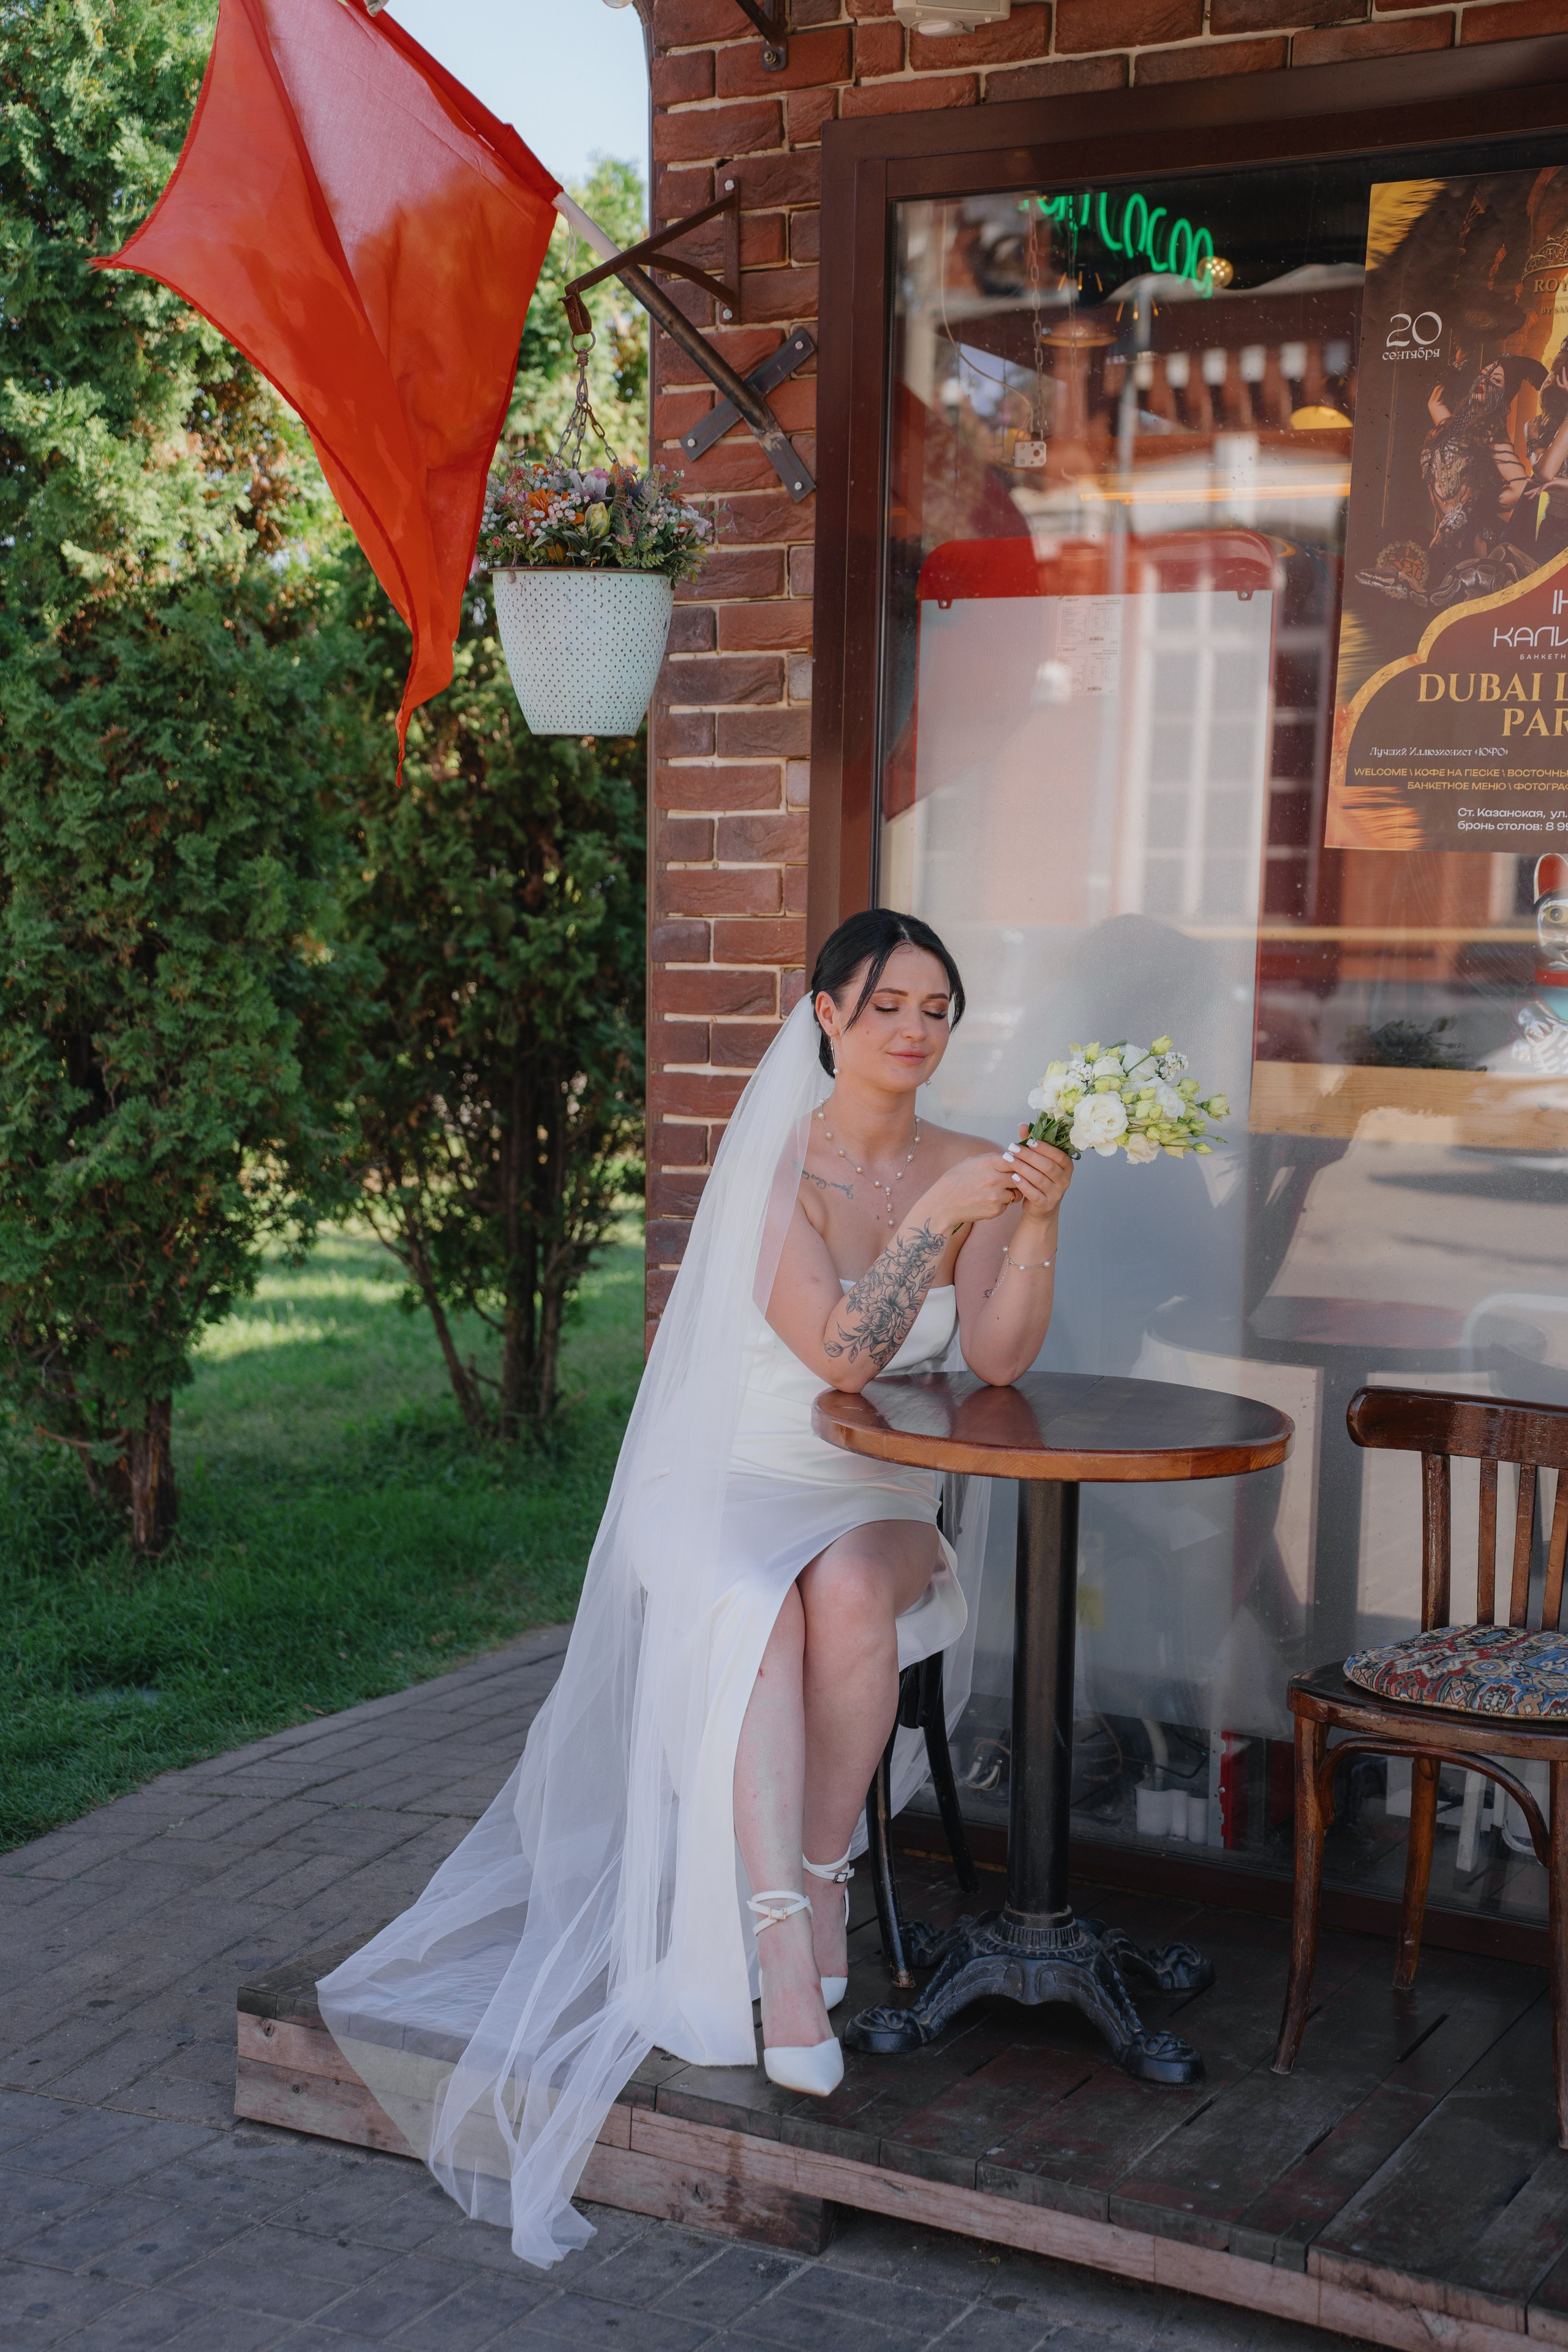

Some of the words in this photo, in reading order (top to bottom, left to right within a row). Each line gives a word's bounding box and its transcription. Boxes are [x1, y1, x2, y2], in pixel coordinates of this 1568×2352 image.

[1386, 311, 1442, 347] 20
[1382, 347, 1441, 361] сентября
[1417, 673, 1544, 702] DUBAI
[1370, 747, 1408, 758] Лучший
[1409, 747, 1472, 756] Иллюзионист
[1354, 767, 1408, 776] WELCOME
[1414, 768, 1446, 777] КОФЕ
[1464, 769, 1500, 777] ПЕСКЕ
[1408, 782, 1469, 790] БАНКЕТНОЕ
[1458, 807, 1475, 816] Ст.
[1477, 808, 1546, 819] Казанская,
[1550, 810, 1568, 820] ул.
[1458, 820, 1494, 831] бронь
[1545, 822, 1555, 831] 8
